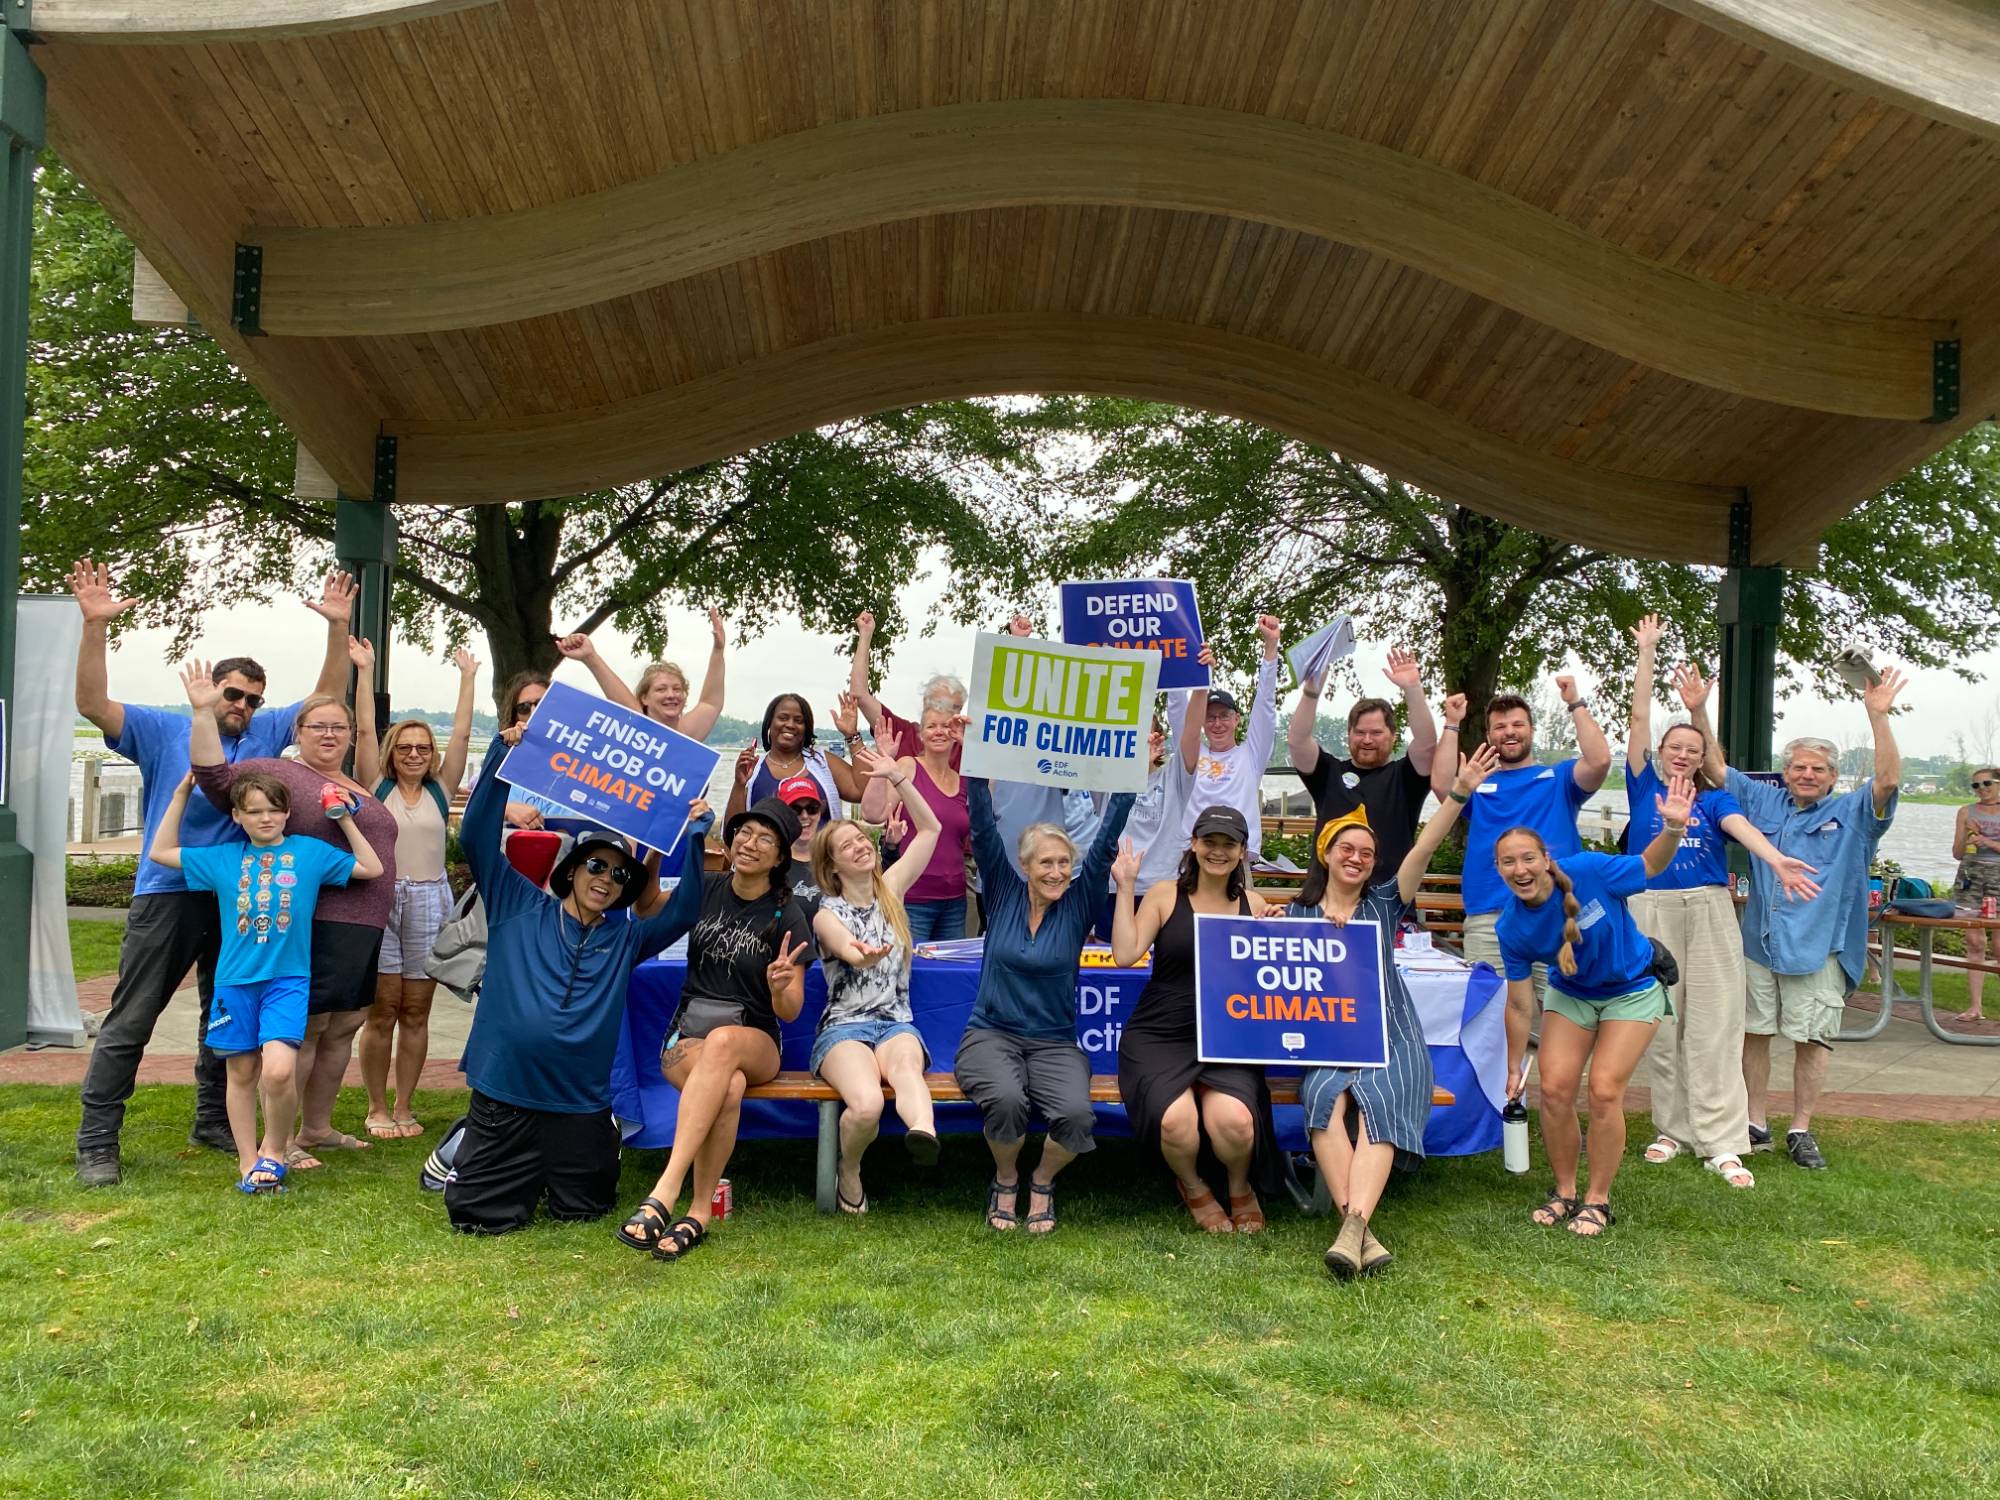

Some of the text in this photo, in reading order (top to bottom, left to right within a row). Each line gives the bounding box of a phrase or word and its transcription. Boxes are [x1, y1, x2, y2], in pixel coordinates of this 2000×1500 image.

[1086, 592, 1178, 616] DEFEND
[1108, 616, 1161, 638] OUR
[1003, 652, 1132, 720] UNITE
[585, 710, 668, 760] FINISH
[982, 714, 1137, 759] FOR CLIMATE
[545, 719, 686, 797] THE JOB ON
[1054, 761, 1069, 769] EDF
[549, 752, 655, 812] CLIMATE
[1053, 769, 1079, 778] Action
[1230, 935, 1347, 963] DEFEND
[1256, 965, 1324, 992] OUR
[1074, 985, 1120, 1016] DF
[1226, 994, 1357, 1023] CLIMATE
